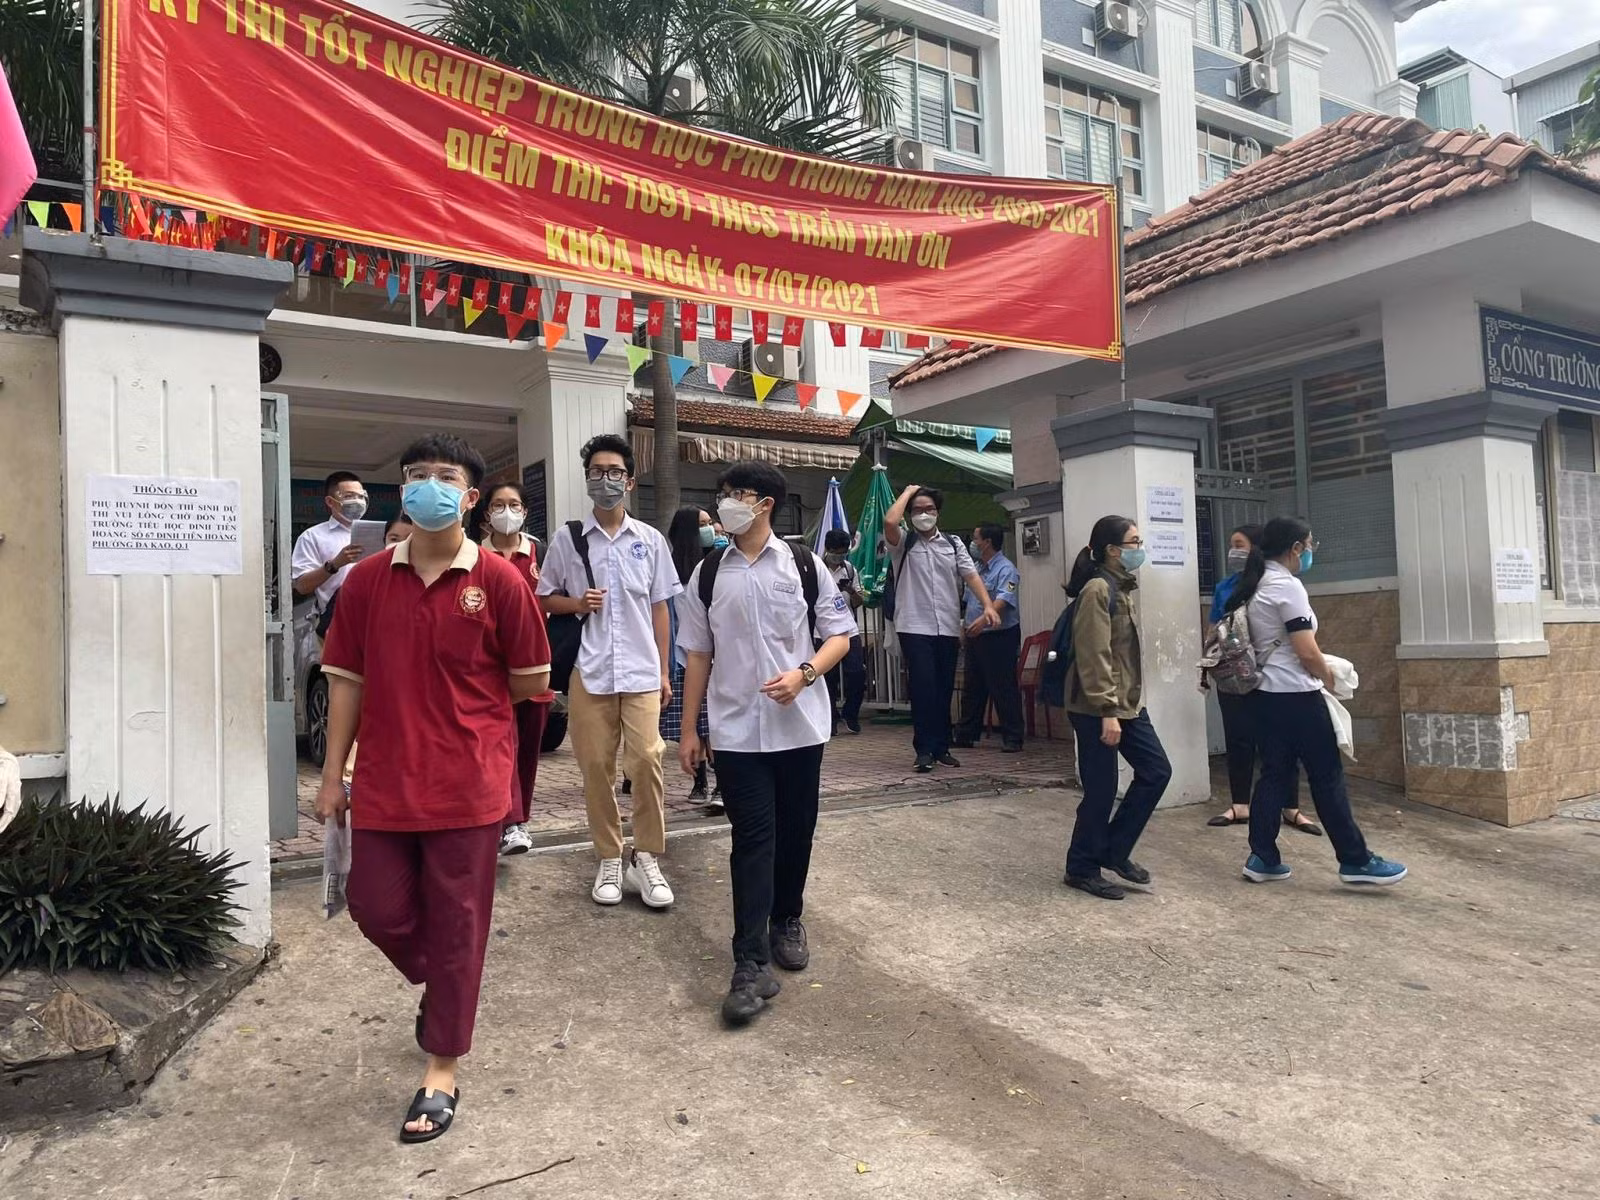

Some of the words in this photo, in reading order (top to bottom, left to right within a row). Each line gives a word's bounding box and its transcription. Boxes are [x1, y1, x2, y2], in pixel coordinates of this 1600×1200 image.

[226, 0, 285, 48] THI
[299, 11, 372, 70] TỐT
[535, 84, 648, 151] TRUNG
[651, 123, 719, 169] HỌC
[937, 184, 986, 223] HỌC
[991, 194, 1098, 238] 2020-2021
[445, 124, 541, 189] ĐIỂM
[551, 153, 613, 204] THI:
[784, 208, 857, 253] TRẦN
[861, 221, 913, 264] VĂN
[916, 230, 952, 270] ƠN
[544, 226, 634, 276] KHÓA
[641, 244, 727, 293] NGÀY:
[734, 262, 880, 316] 07/07/2021
[1501, 334, 1545, 379] CỔNG
[132, 484, 173, 494] THÔNG
[175, 485, 198, 496] BÁO
[92, 500, 110, 509] PHỤ
[198, 504, 219, 512] SINH
[92, 510, 109, 518] THI
[222, 514, 237, 523] TẠI
[164, 522, 185, 531] HỌC
